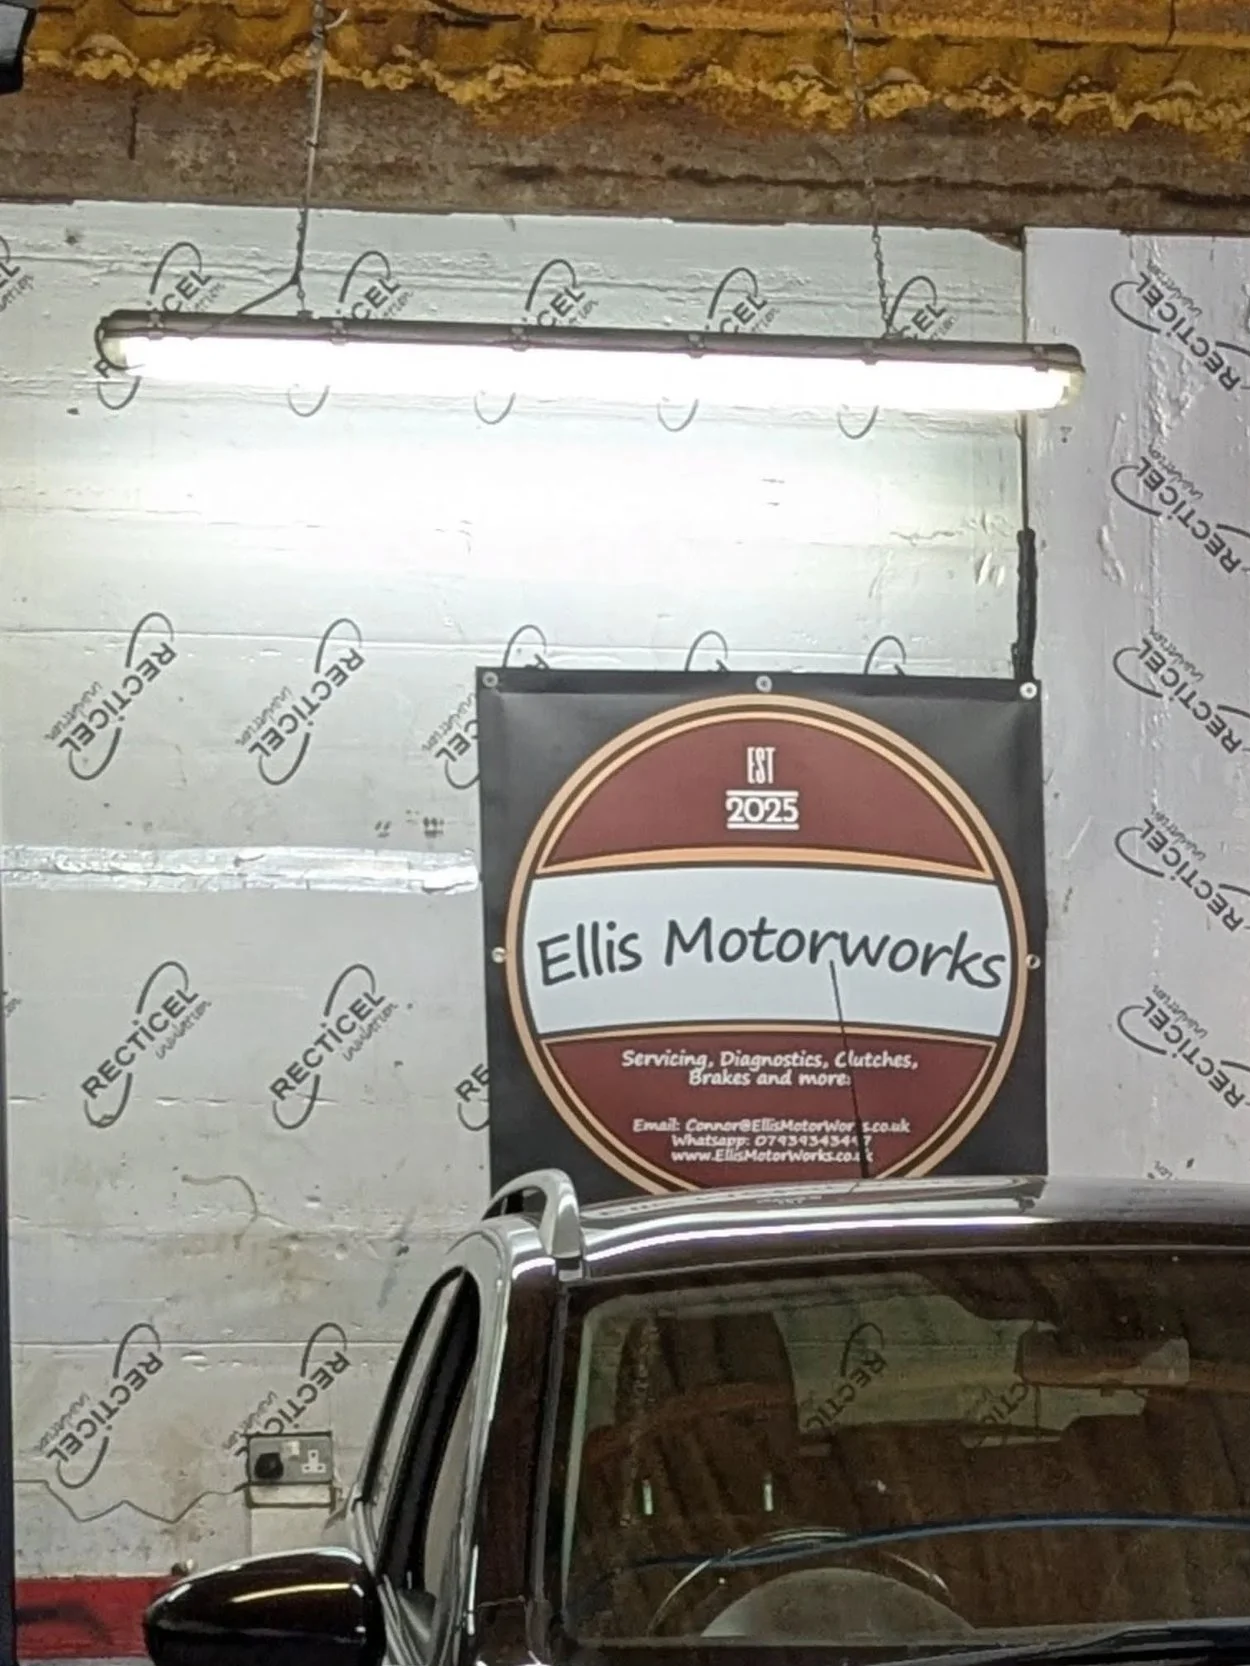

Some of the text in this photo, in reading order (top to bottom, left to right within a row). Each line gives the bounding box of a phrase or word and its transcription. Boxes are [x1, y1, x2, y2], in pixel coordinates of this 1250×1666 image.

[747, 747, 776, 784] EST
[725, 797, 799, 822] 2025
[537, 916, 1006, 989] Ellis Motorworks
[622, 1049, 918, 1071] Servicing, Diagnostics, Clutches,
[689, 1068, 751, 1085] Brakes
[756, 1068, 792, 1085] and
[632, 1117, 910, 1133] Email: Connor@EllisMotorWors.co.uk
